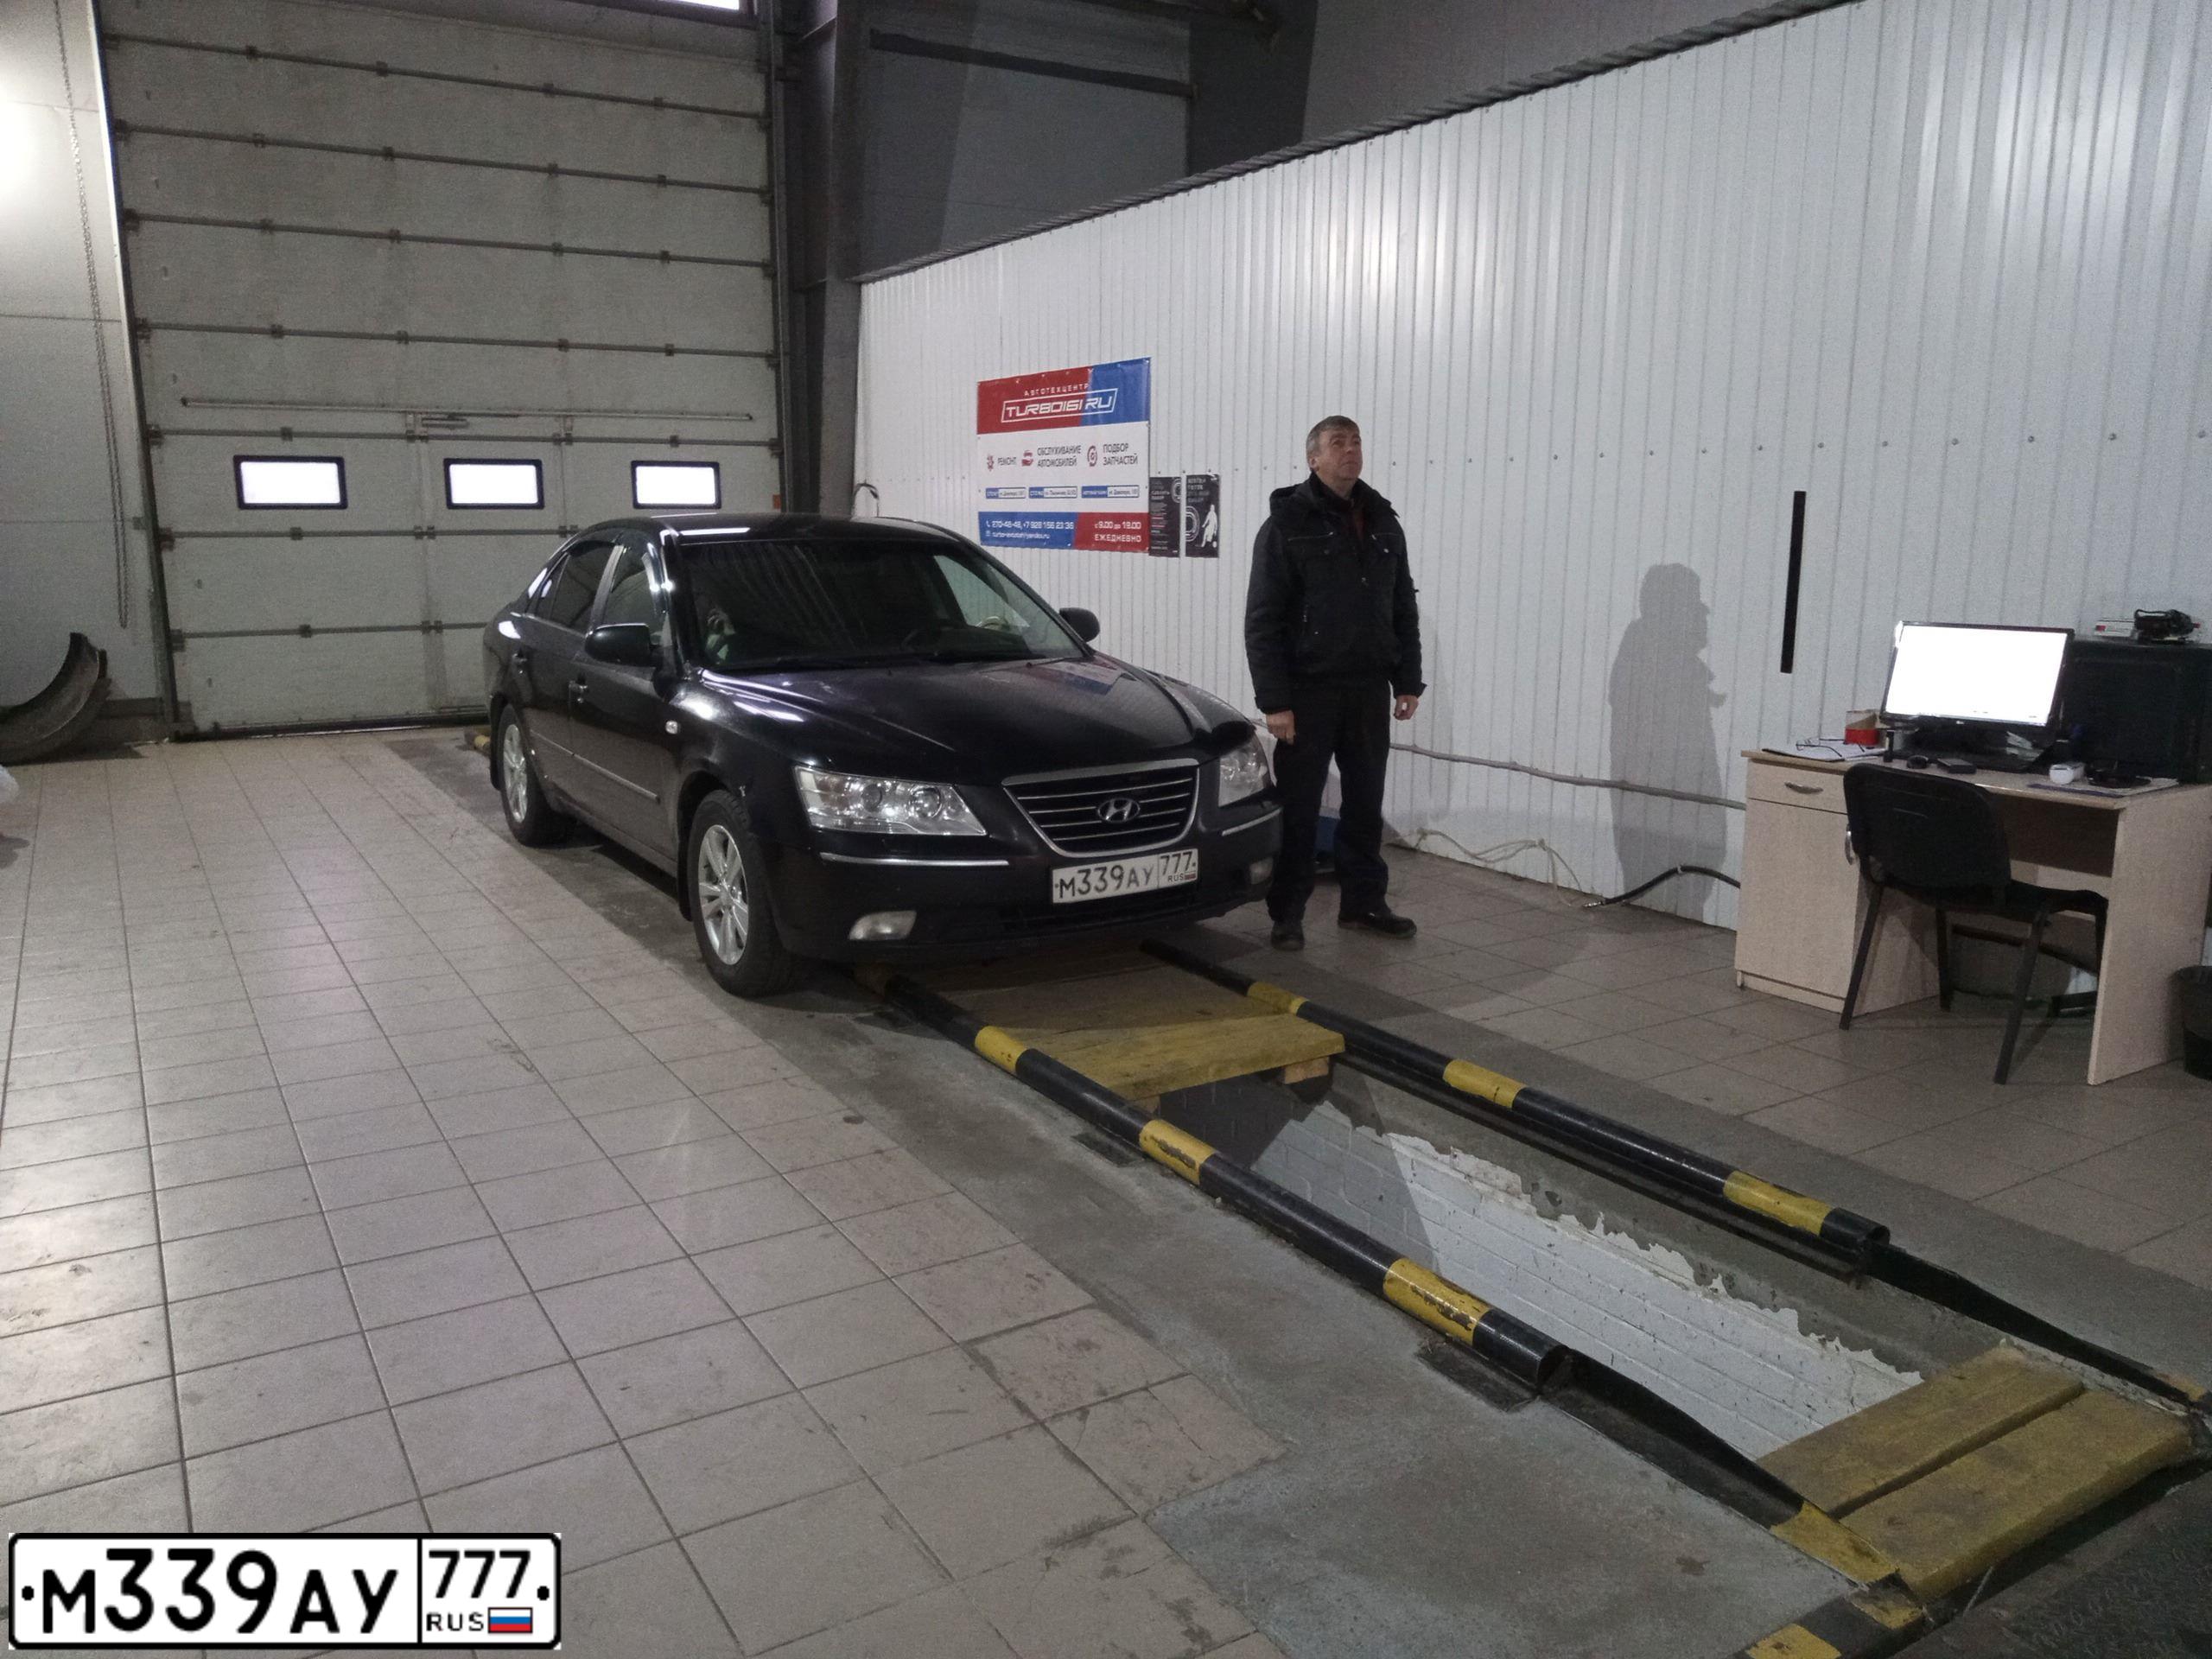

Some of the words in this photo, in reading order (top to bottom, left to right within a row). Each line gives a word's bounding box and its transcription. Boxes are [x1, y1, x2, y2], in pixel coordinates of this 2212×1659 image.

[1024, 383, 1090, 397] АВТОТЕХЦЕНТР
[1037, 445, 1081, 456] ОБСЛУЖИВАНИЕ
[1103, 442, 1129, 454] ПОДБОР
[1037, 456, 1077, 467] АВТОМОБИЛЕЙ
[1103, 453, 1139, 467] ЗАПЧАСТЕЙ
[1094, 533, 1141, 543] ЕЖЕДНЕВНО
[1160, 850, 1193, 876] 777
[1167, 873, 1185, 882] RUS
